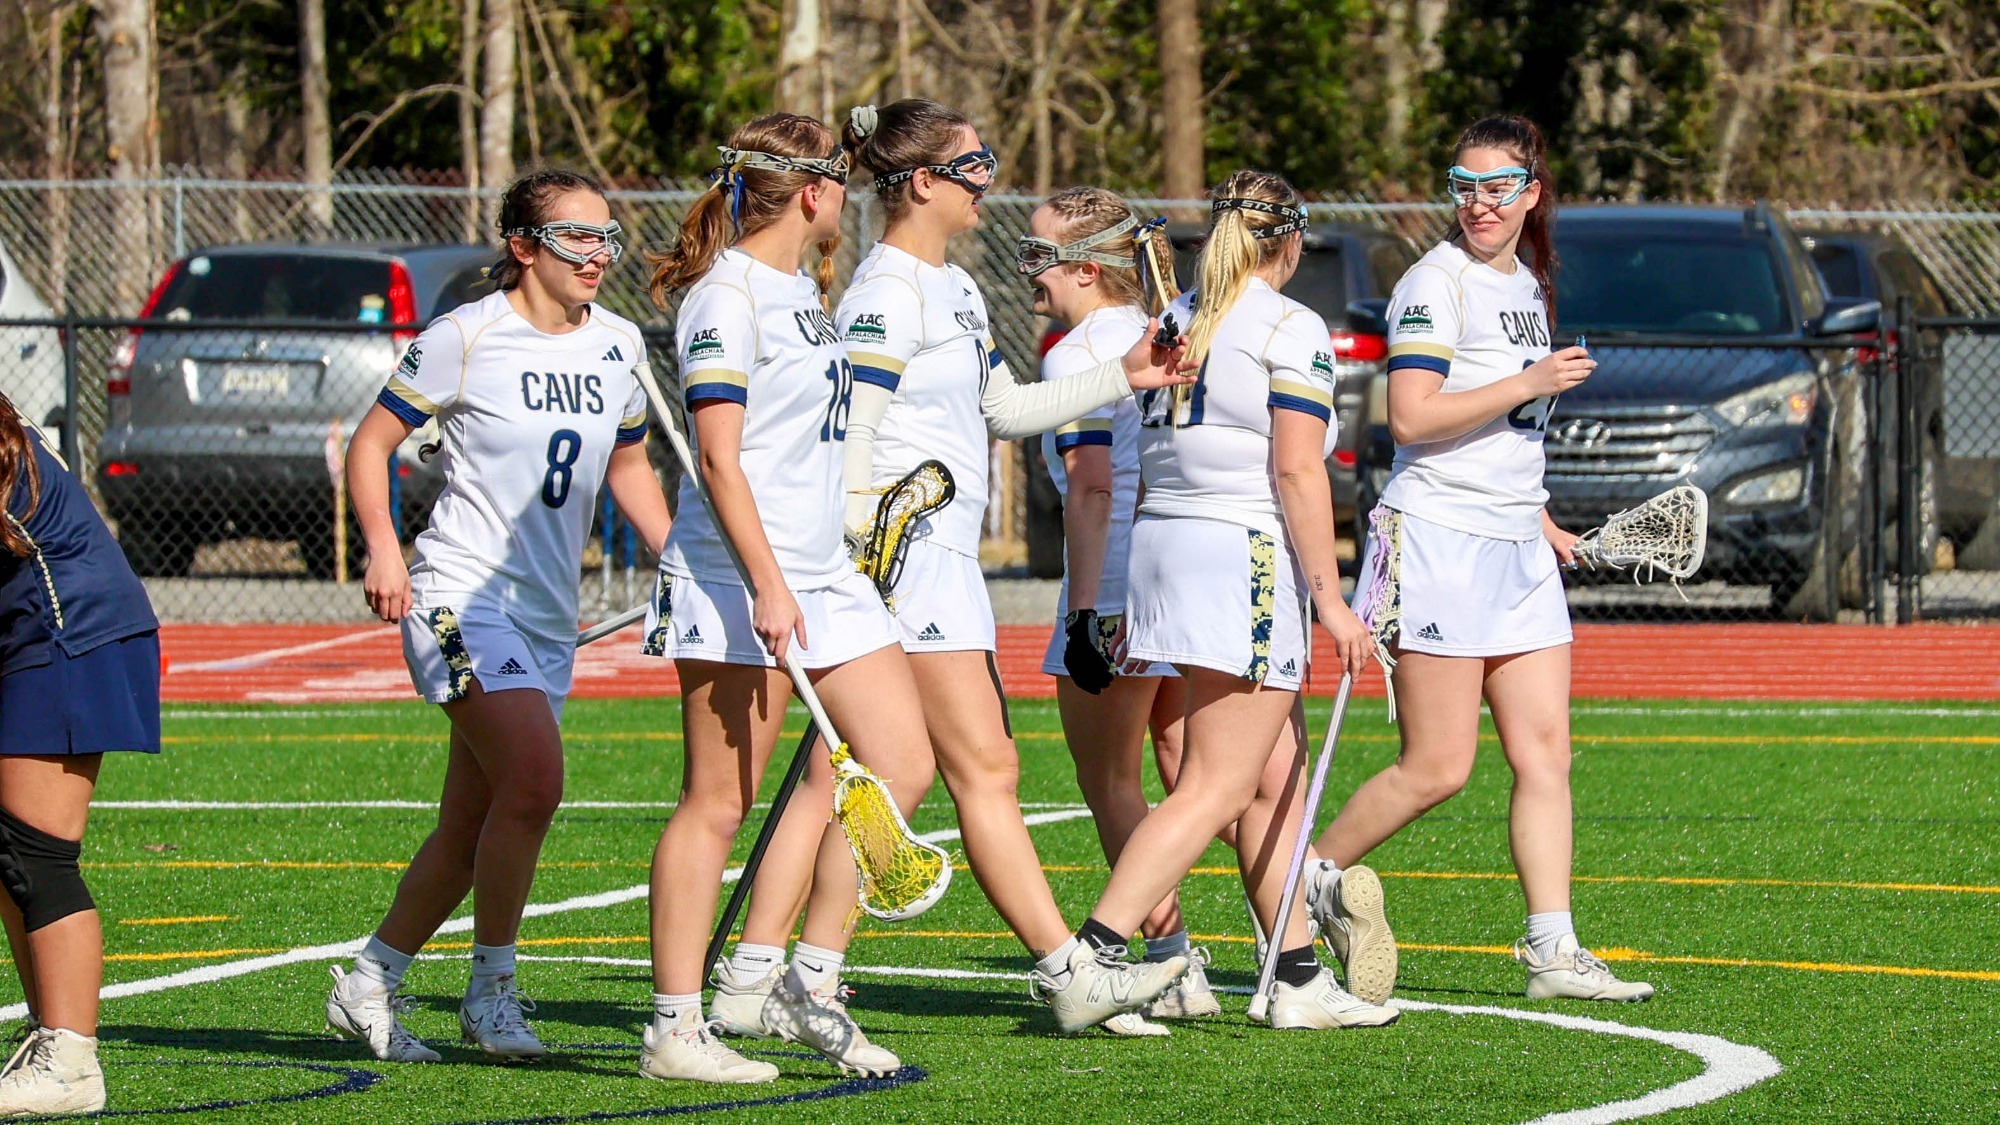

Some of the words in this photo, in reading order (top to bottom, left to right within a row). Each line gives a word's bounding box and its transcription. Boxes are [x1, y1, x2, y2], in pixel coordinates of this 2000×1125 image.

[889, 168, 914, 184] STX
[929, 165, 954, 175] TX
[1214, 199, 1233, 210] STX
[1241, 199, 1274, 212] STX
[1281, 206, 1299, 220] STX
[1273, 221, 1296, 236] STX
[1065, 251, 1093, 260] STX
[1404, 304, 1429, 318] AAC
[855, 313, 884, 326] AAC
[1396, 322, 1434, 331] APPALACHIAN
[693, 328, 718, 343] AAC
[844, 331, 887, 341] APPALACHIAN
[1500, 311, 1548, 347] CAVS
[521, 371, 604, 414] CAVS
[820, 358, 853, 442] 18
[541, 428, 582, 509] 8
[680, 636, 704, 644] adidas
[917, 633, 945, 641] adidas
[1416, 631, 1443, 641] adidas
